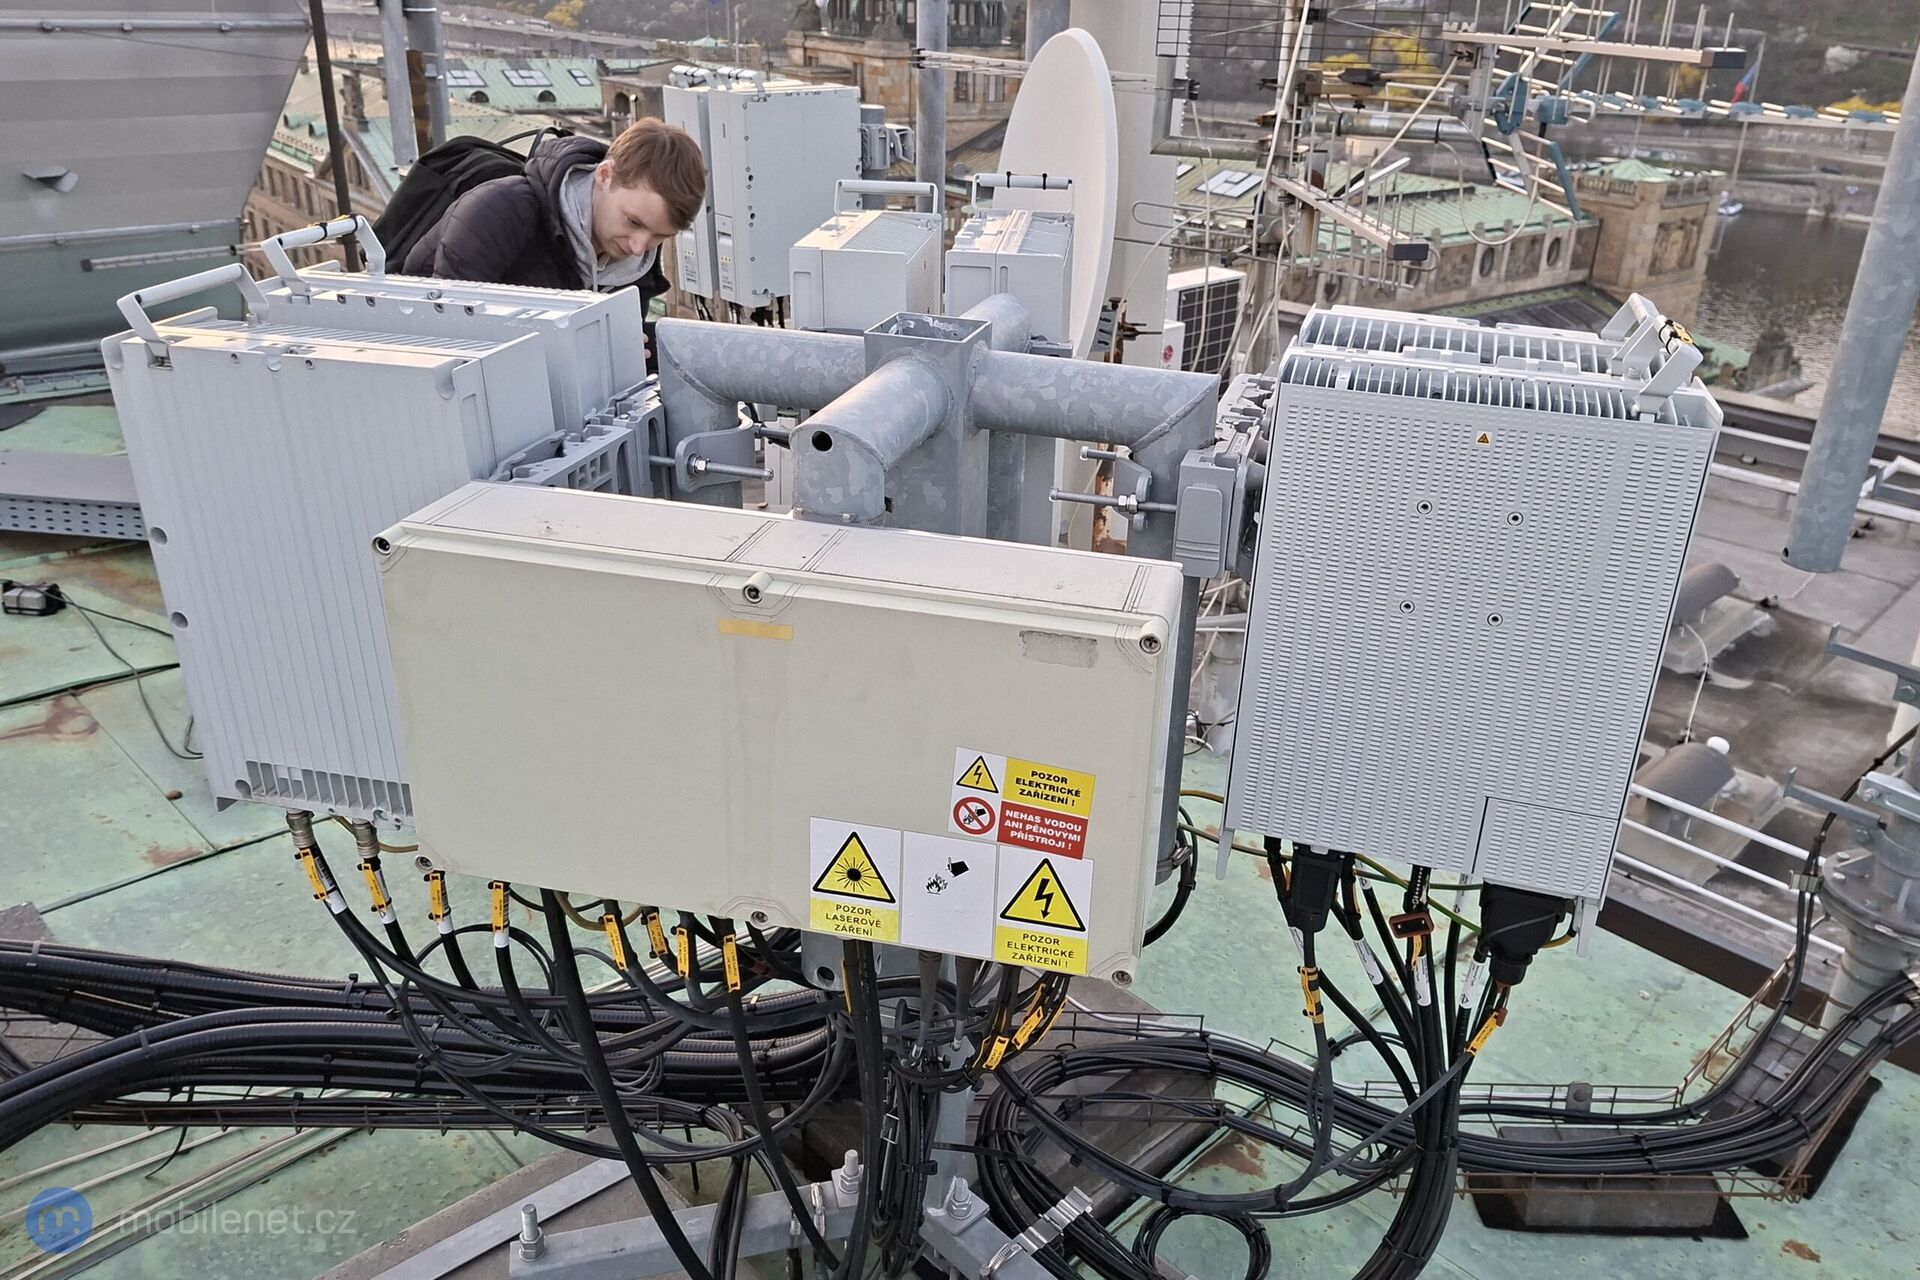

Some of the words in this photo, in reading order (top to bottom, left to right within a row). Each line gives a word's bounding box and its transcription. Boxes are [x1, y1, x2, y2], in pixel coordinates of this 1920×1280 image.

[1031, 770, 1068, 784] POZOR
[1015, 777, 1081, 797] ELEKTRICKÉ
[1019, 788, 1068, 805] ZAŘÍZENÍ
[1005, 809, 1041, 823] NEHAS
[1044, 817, 1082, 832] VODOU
[1004, 819, 1023, 829] ANI
[1025, 824, 1081, 842] PĚNOVÝMI
[1010, 830, 1065, 849] PŘÍSTROJI
[835, 904, 872, 916] POZOR
[825, 913, 882, 928] LASEROVÉ
[834, 923, 873, 936] ZÁŘENÍ
[1022, 933, 1060, 946] POZOR
[1007, 941, 1074, 959] ELEKTRICKÉ
[1011, 952, 1061, 966] ZAŘÍZENÍ
